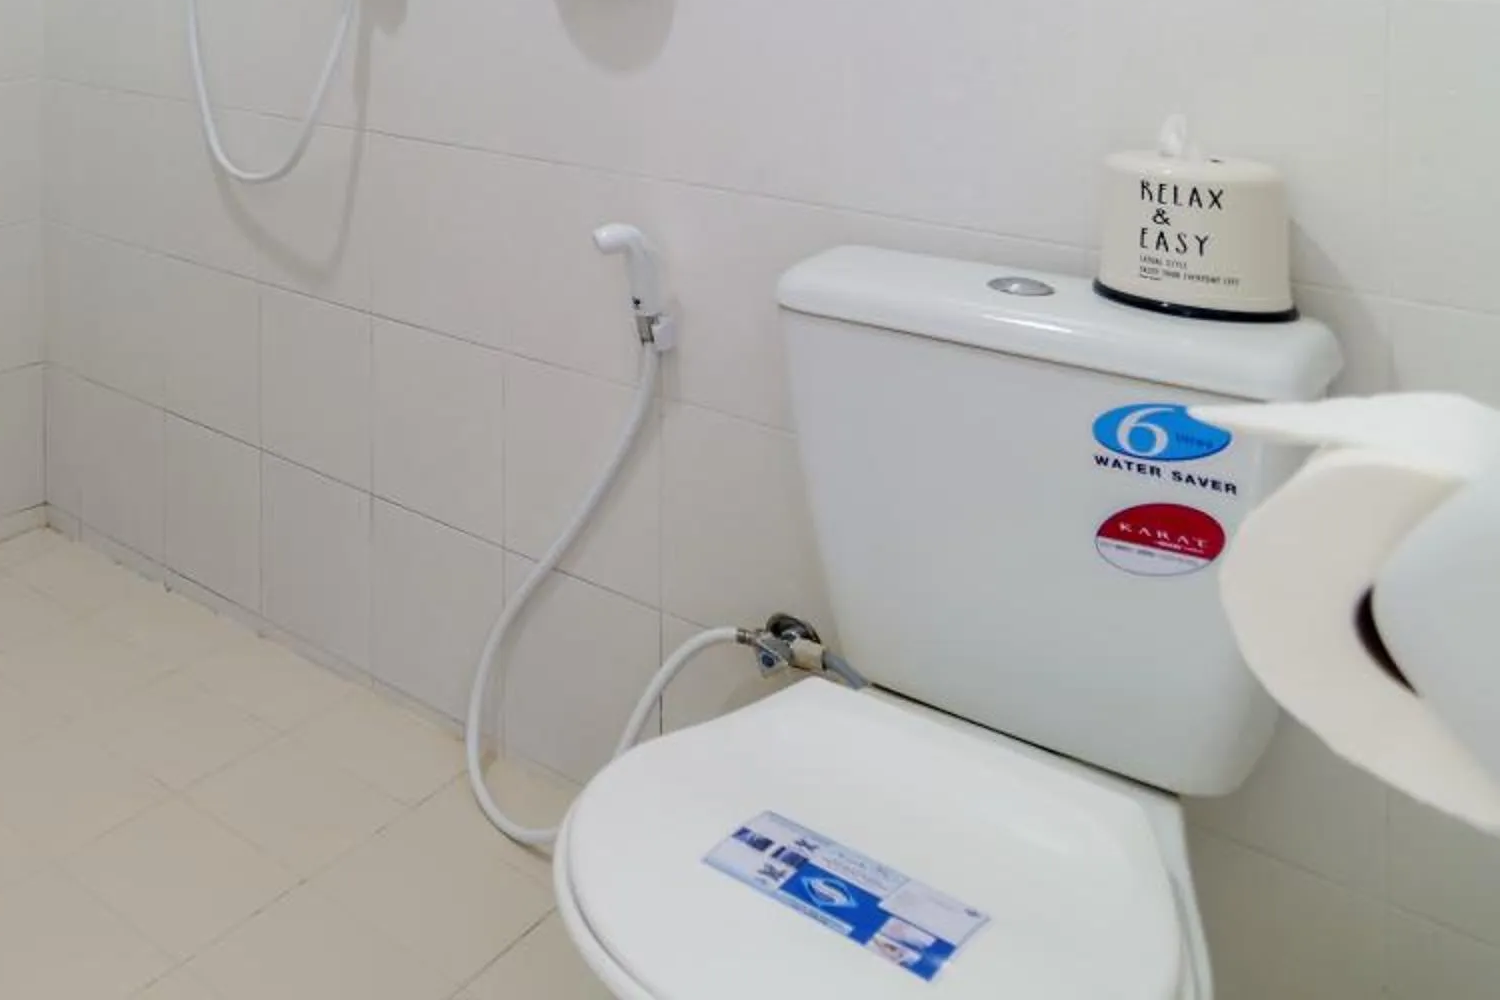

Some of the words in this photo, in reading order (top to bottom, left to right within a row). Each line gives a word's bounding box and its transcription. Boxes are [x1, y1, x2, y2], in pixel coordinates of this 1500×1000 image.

[1140, 179, 1223, 210] RELAX
[1152, 208, 1171, 226] &
[1139, 227, 1209, 257] EASY
[1116, 407, 1176, 457] 6
[1094, 455, 1162, 479] WATER
[1171, 468, 1238, 496] SAVER
[1118, 521, 1209, 549] KARAT
